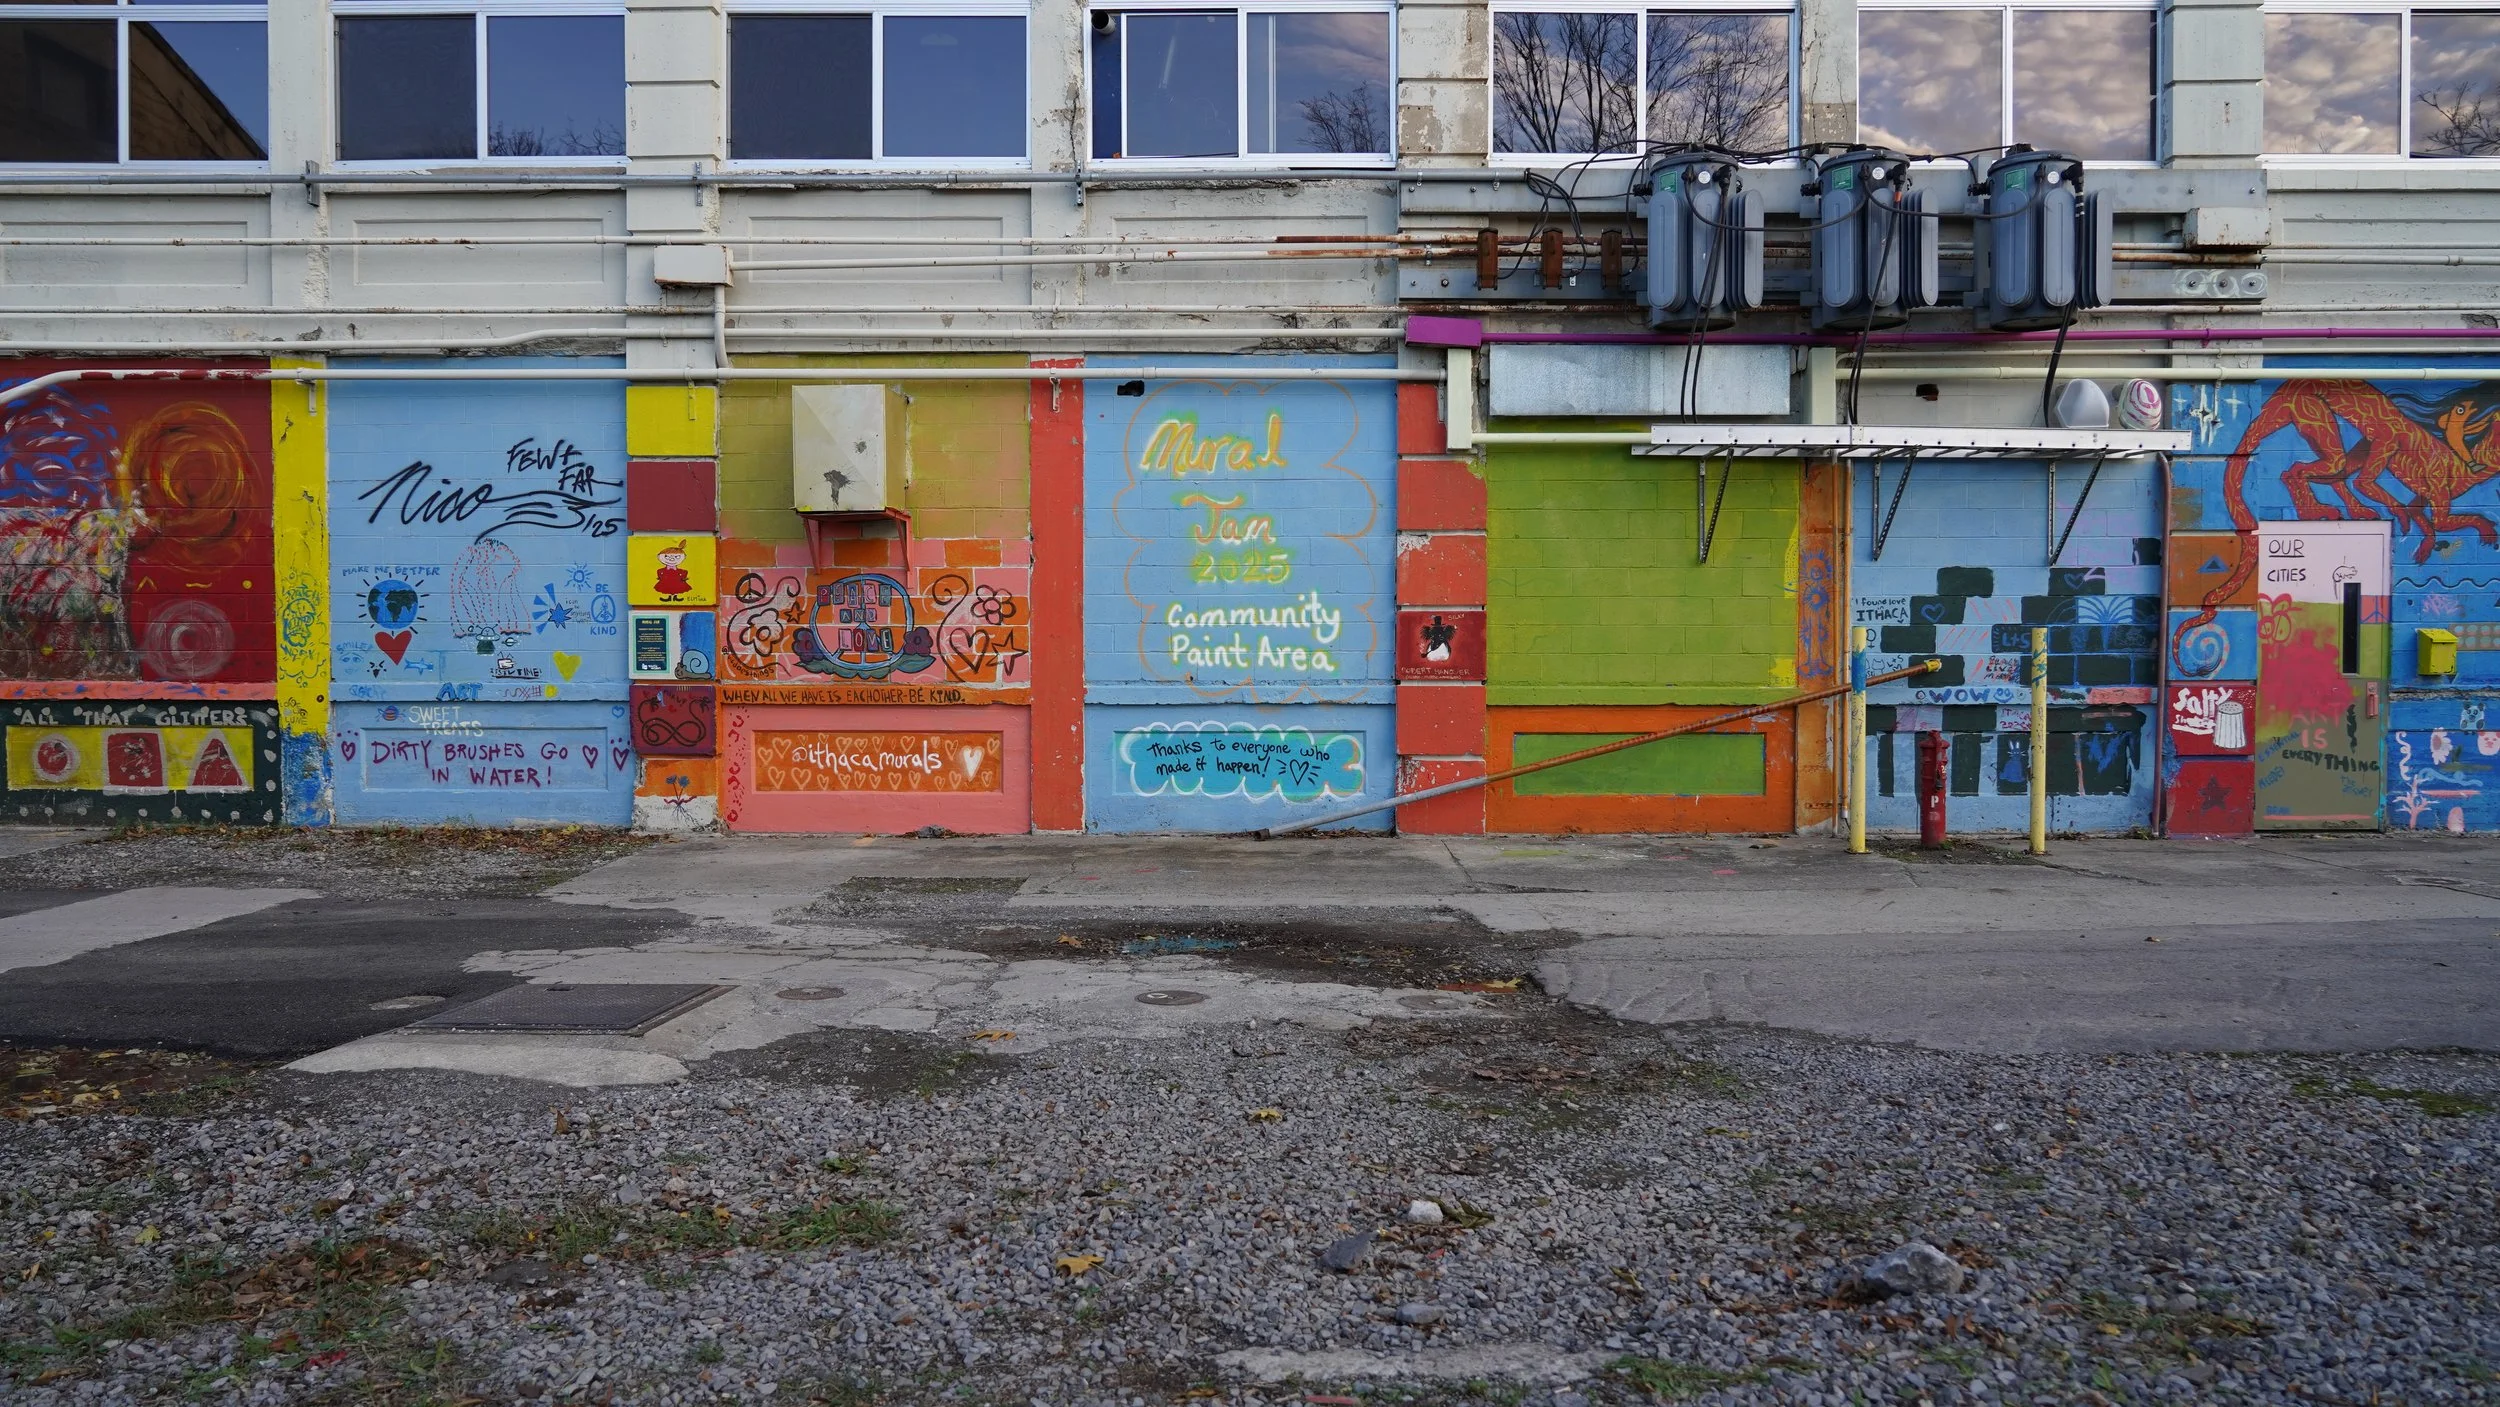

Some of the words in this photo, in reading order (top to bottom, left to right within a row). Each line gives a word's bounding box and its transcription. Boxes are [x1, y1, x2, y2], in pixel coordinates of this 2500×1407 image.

[1140, 414, 1287, 477] Mural
[558, 462, 624, 496] FAR
[358, 461, 493, 524] Nico
[2269, 539, 2305, 558] OUR
[342, 565, 369, 577] MAKE
[374, 565, 390, 574] ME
[394, 566, 441, 576] BETTER
[1193, 552, 1291, 583] 2025
[2267, 568, 2306, 582] CITIES
[595, 584, 609, 593] BE
[818, 584, 891, 605] PEACE
[1861, 597, 1887, 606] found
[1888, 597, 1907, 606] love
[841, 610, 876, 621] AND
[1168, 591, 1341, 644] Community
[1856, 608, 1909, 622] ITHACA
[590, 626, 617, 635] KIND
[839, 629, 891, 651] LOVE
[1173, 632, 1249, 668] Paint
[1257, 635, 1335, 671] Area
[436, 681, 483, 701] ART
[723, 690, 760, 703] WHEN
[762, 690, 777, 702] ALL
[780, 690, 797, 702] WE
[801, 690, 826, 703] HAVE
[828, 690, 843, 702] IS
[2173, 686, 2233, 718] Salty
[20, 708, 59, 725] ALL
[83, 710, 131, 725] THAT
[155, 708, 248, 726] GLITTERS
[408, 705, 462, 723] SWEET
[419, 721, 484, 738] TREATS
[2301, 727, 2329, 750] IS
[444, 742, 526, 763] BRUSHES
[1210, 738, 1226, 751] to
[1231, 741, 1291, 762] everyone
[1299, 745, 1331, 761] who
[1156, 758, 1192, 776] made
[1216, 757, 1271, 778] happen!
[2281, 749, 2381, 773] EVERYTHING
[431, 767, 450, 783] IN
[1930, 795, 1939, 808] P
